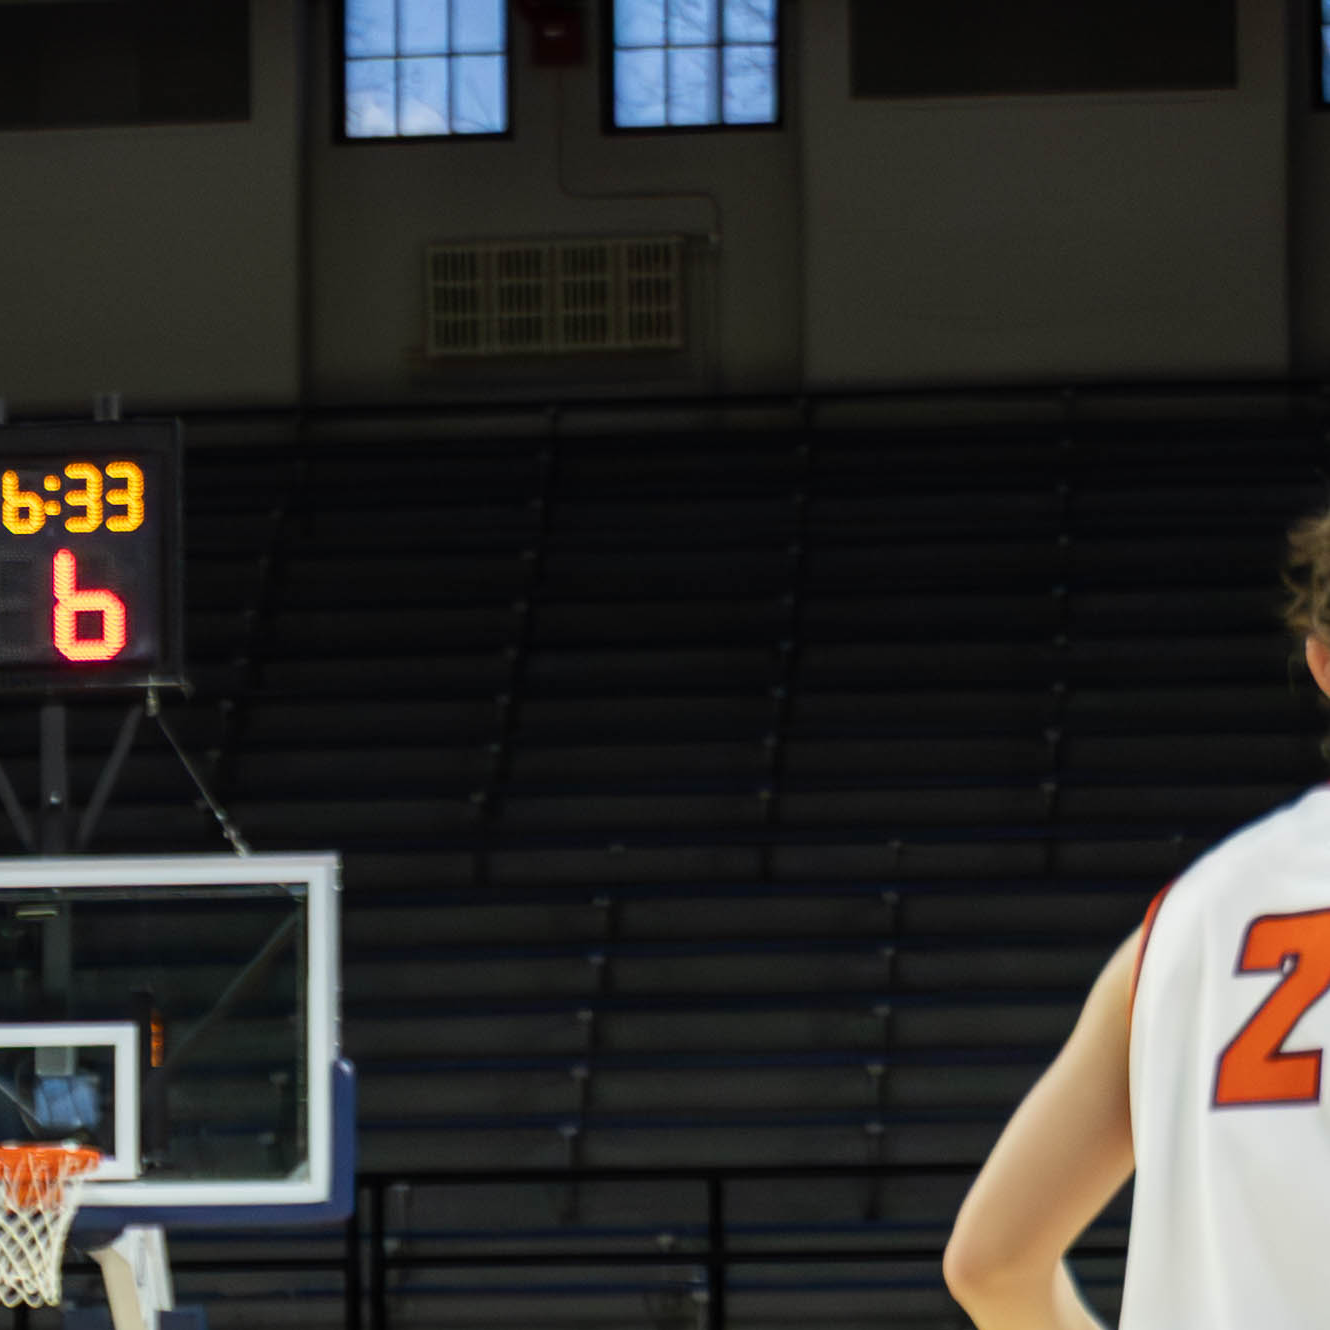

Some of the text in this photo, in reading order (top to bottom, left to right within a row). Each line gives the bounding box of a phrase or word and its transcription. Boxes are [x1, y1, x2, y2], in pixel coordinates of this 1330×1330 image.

[1, 461, 144, 535] 6:33
[53, 548, 126, 661] 6
[1209, 906, 1330, 1111] 2
